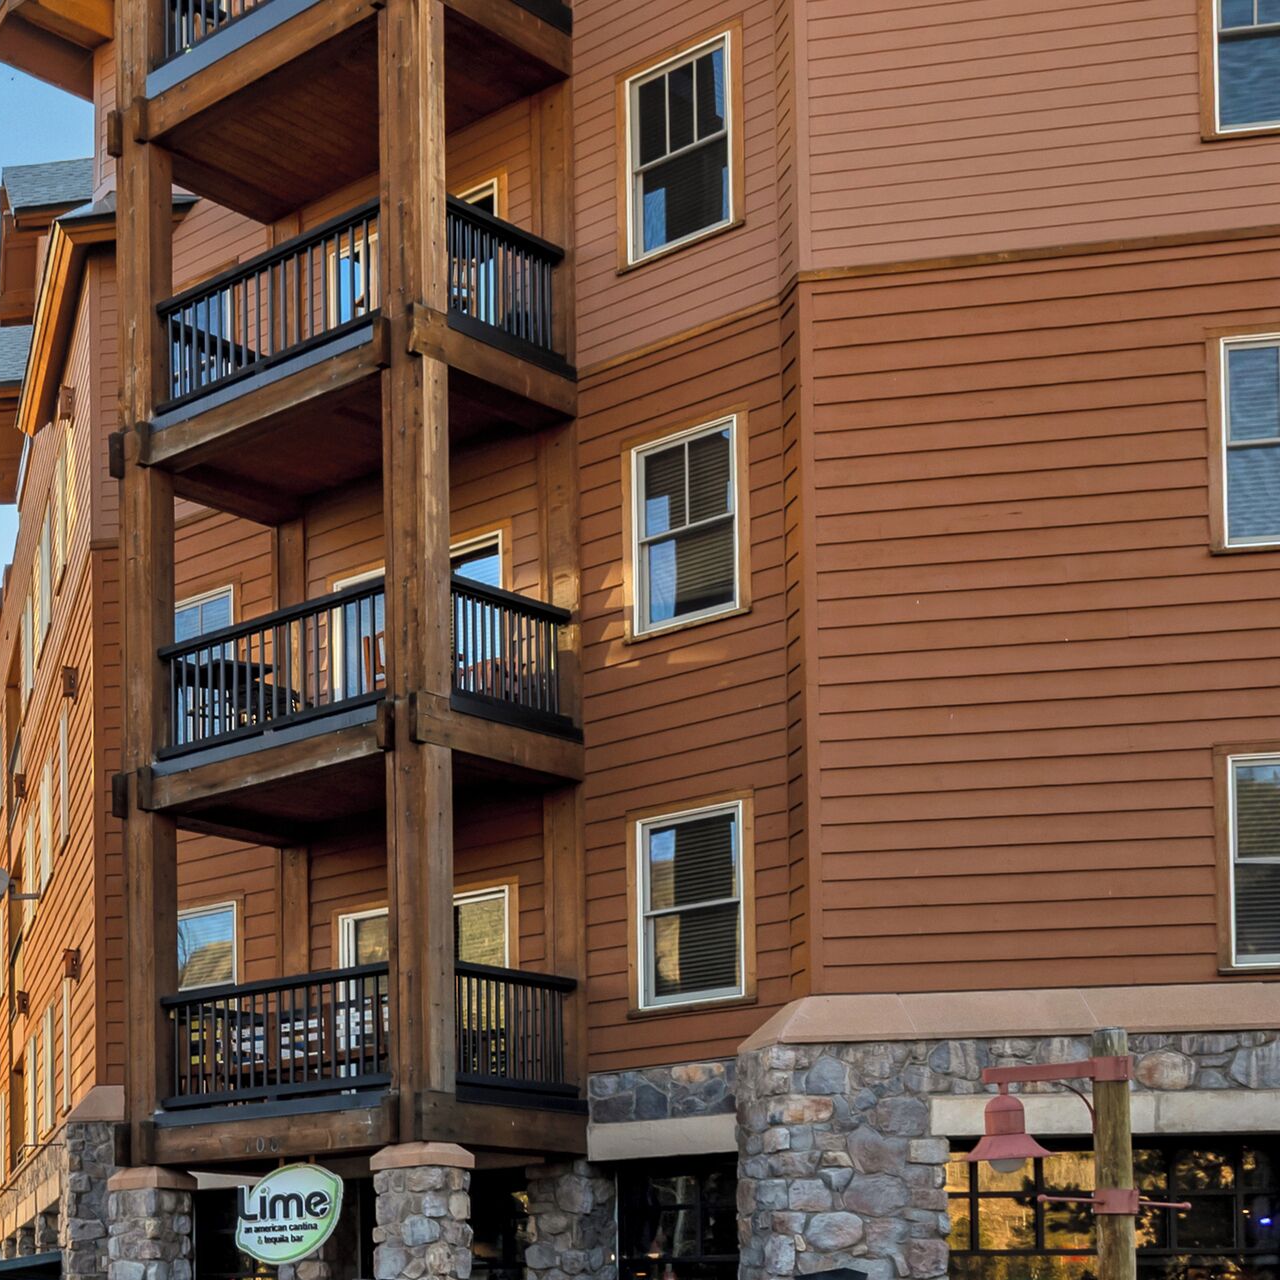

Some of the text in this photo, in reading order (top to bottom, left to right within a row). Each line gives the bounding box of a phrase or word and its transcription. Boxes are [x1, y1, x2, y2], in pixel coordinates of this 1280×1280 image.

[238, 1185, 330, 1221] Lime
[254, 1224, 287, 1232] american
[289, 1222, 318, 1231] cantina
[258, 1234, 303, 1245] & tequila bar
